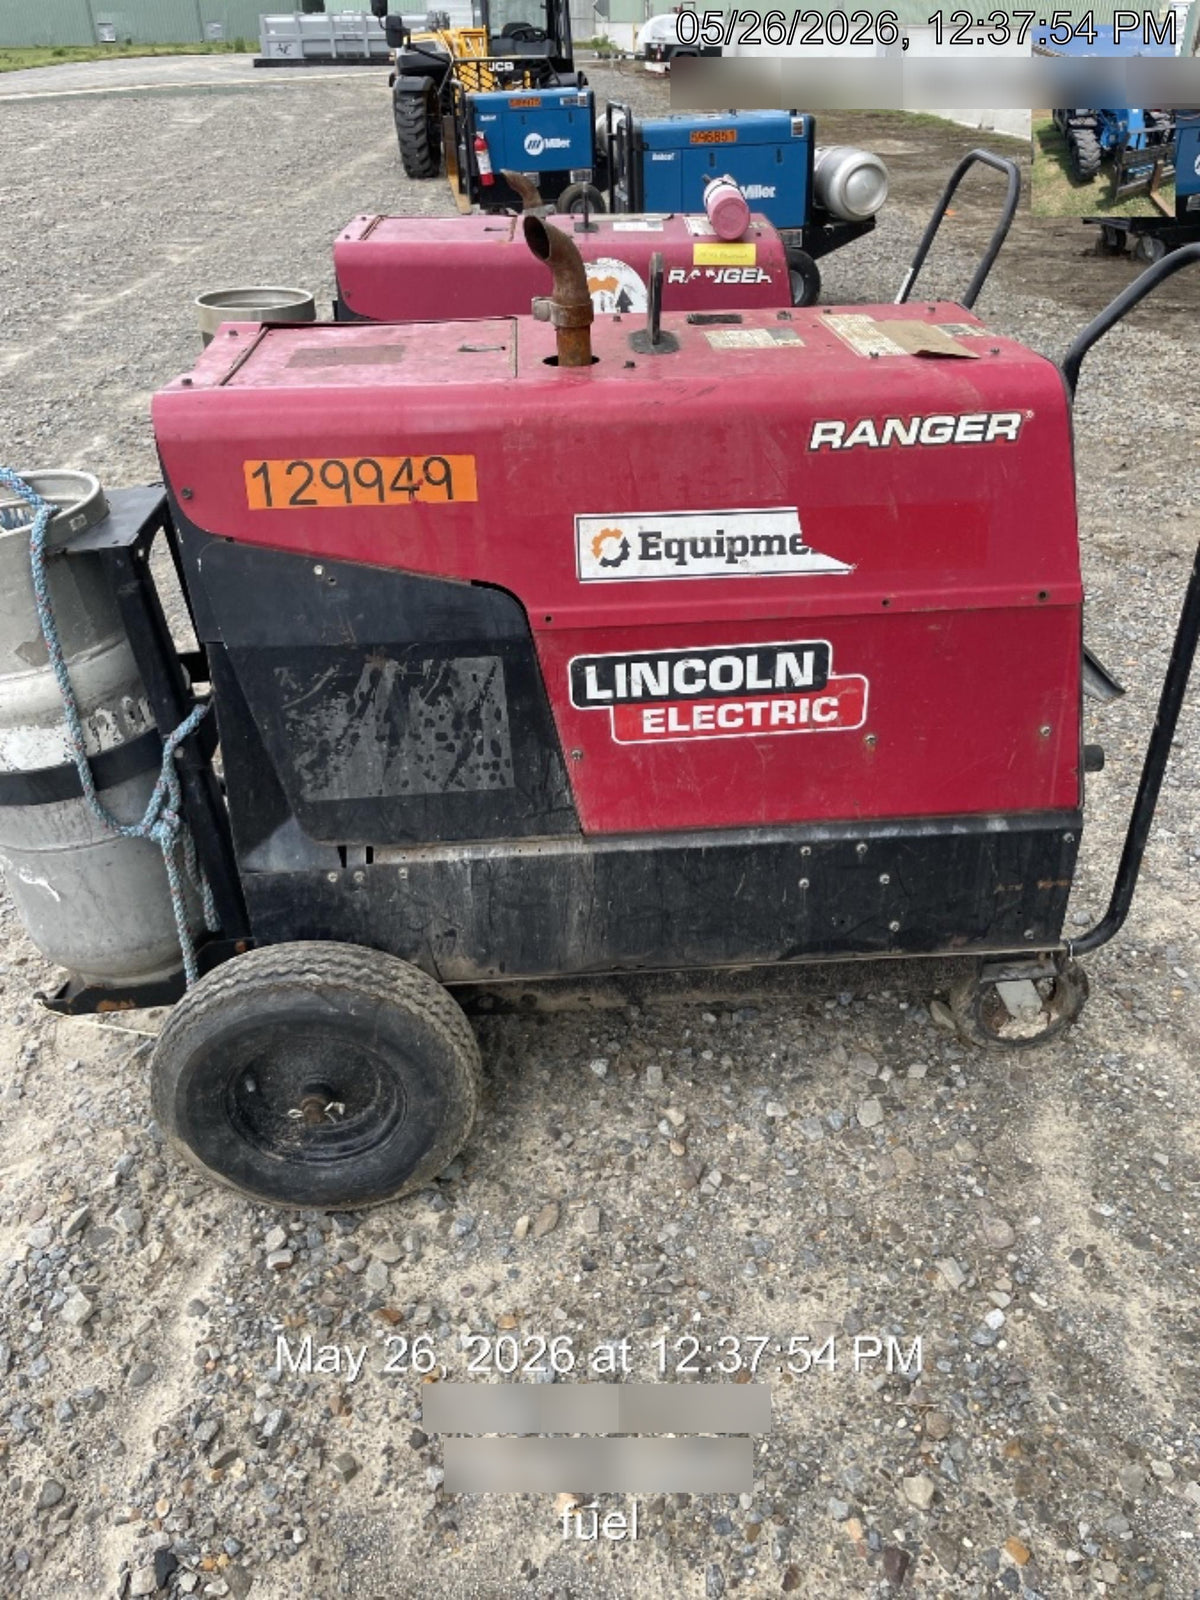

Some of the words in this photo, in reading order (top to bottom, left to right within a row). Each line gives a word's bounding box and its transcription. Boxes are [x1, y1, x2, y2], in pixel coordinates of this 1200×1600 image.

[488, 62, 514, 72] JCB
[809, 411, 1022, 450] RANGER
[252, 456, 454, 507] 129949
[637, 529, 816, 566] Equipme
[584, 651, 816, 701] LINCOLN
[642, 697, 840, 734] ELECTRIC
